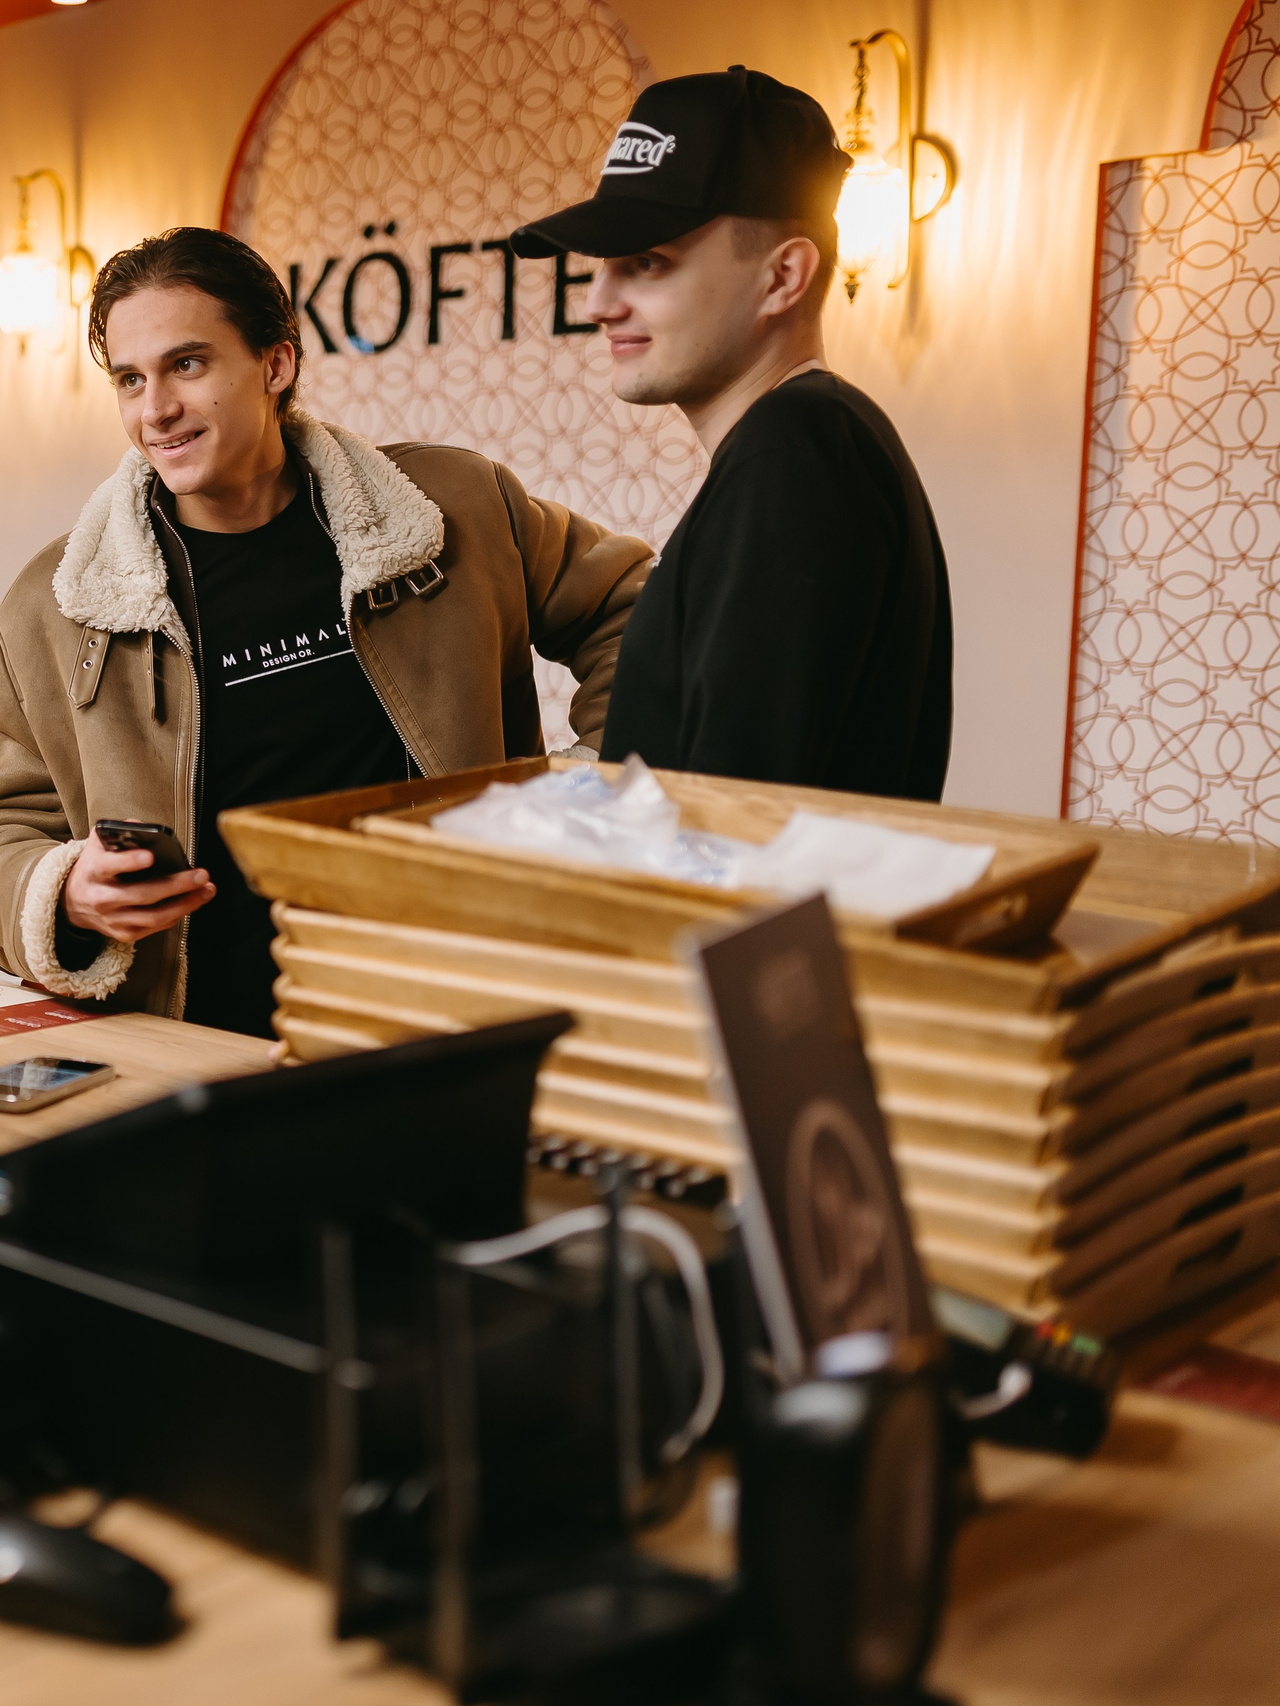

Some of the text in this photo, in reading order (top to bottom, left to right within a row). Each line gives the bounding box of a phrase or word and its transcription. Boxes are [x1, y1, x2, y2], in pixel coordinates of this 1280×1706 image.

[289, 220, 601, 354] KÖFTE
[222, 623, 347, 668] MINIMAL
[262, 652, 298, 668] DESIGN
